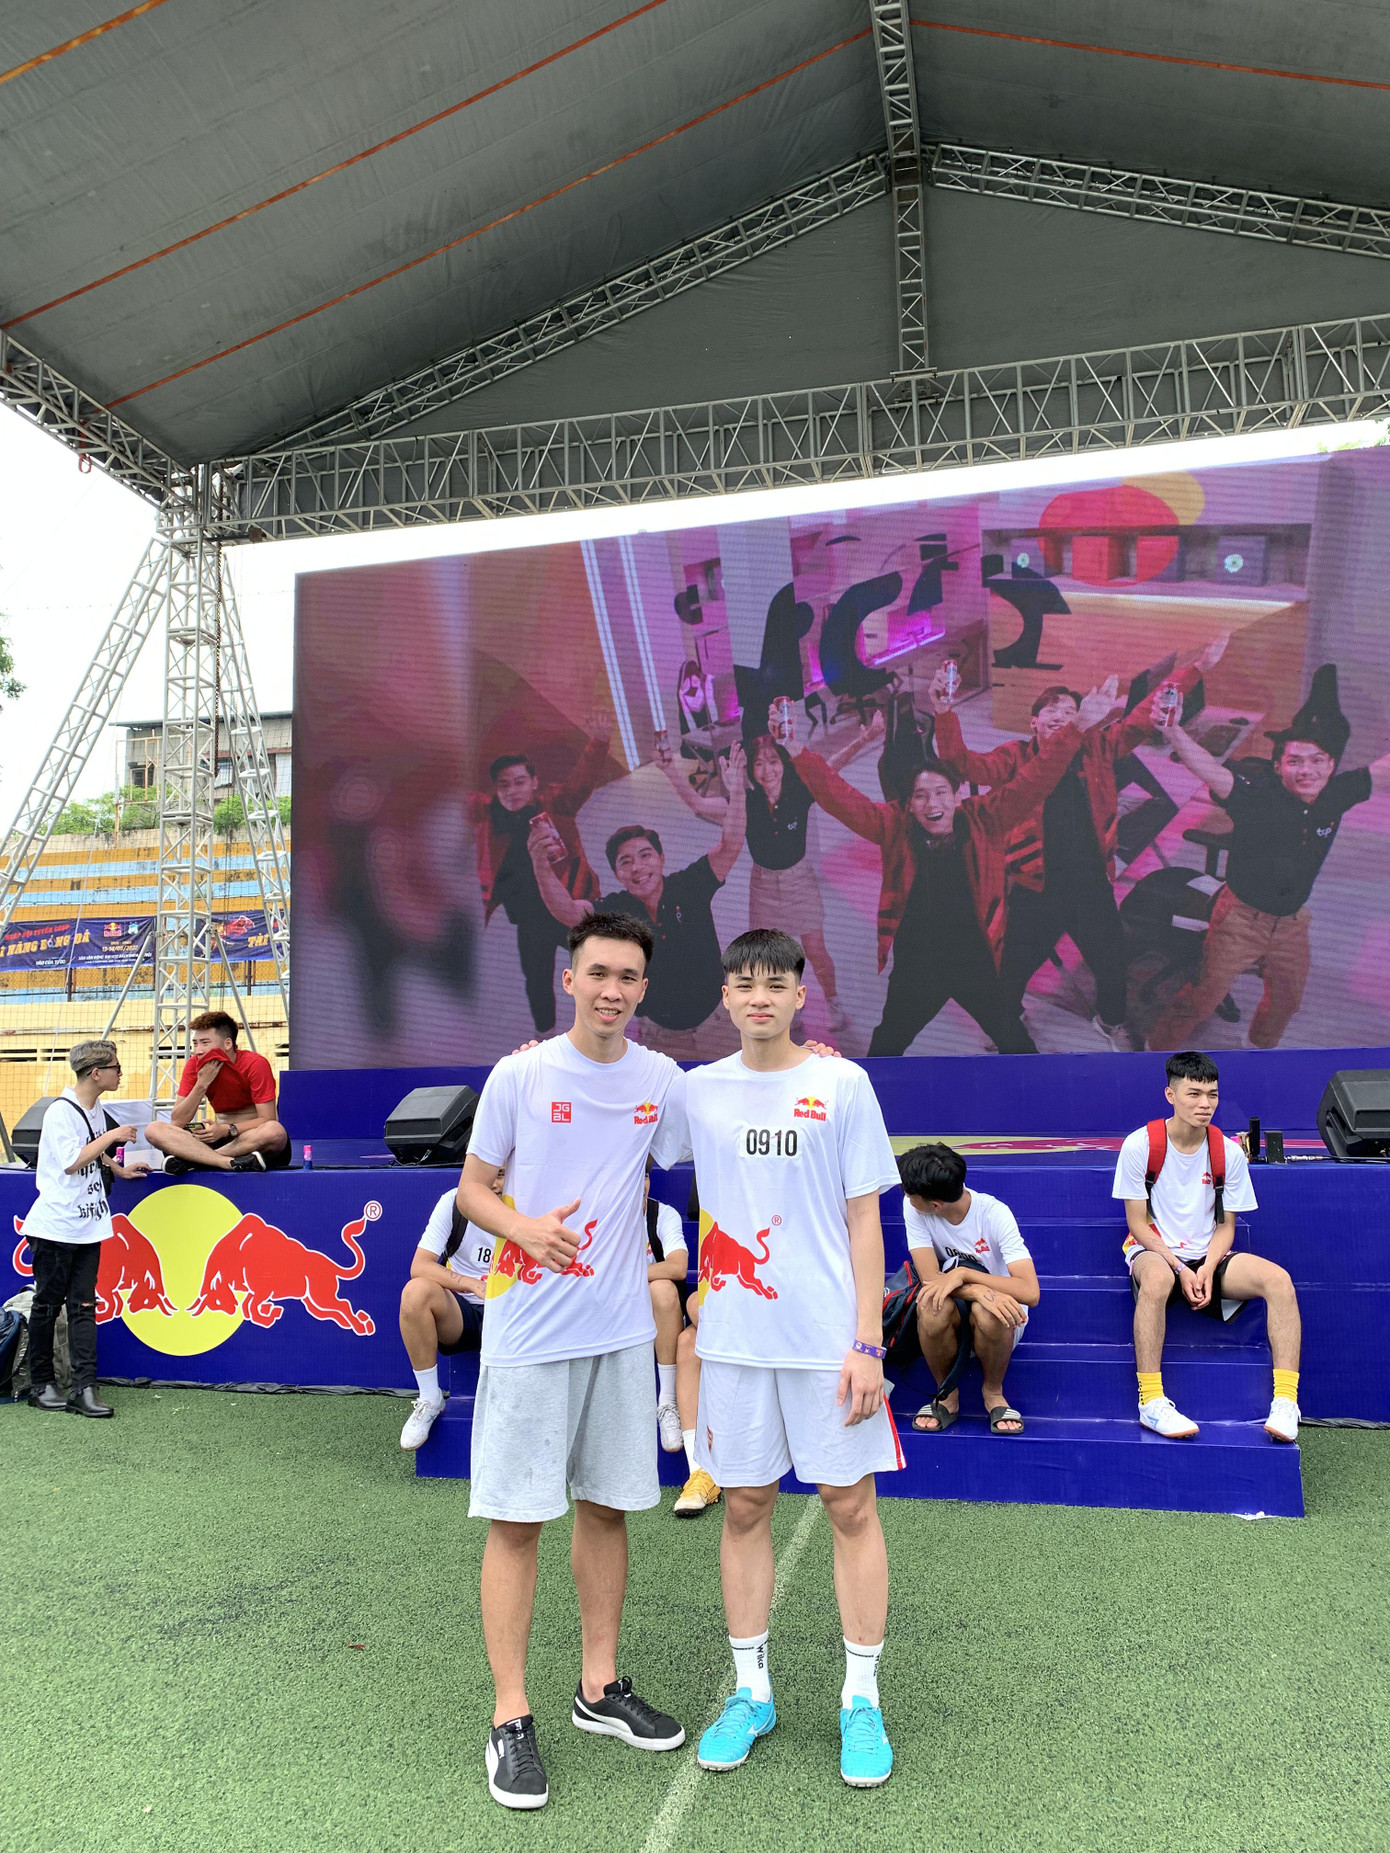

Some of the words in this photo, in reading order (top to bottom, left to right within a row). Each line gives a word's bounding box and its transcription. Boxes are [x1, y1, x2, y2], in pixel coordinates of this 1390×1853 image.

[553, 1103, 570, 1112] JG
[553, 1112, 570, 1121] BL
[634, 1115, 648, 1125] Red
[793, 1108, 810, 1118] Red
[810, 1110, 827, 1122] Bull
[746, 1128, 798, 1157] 0910
